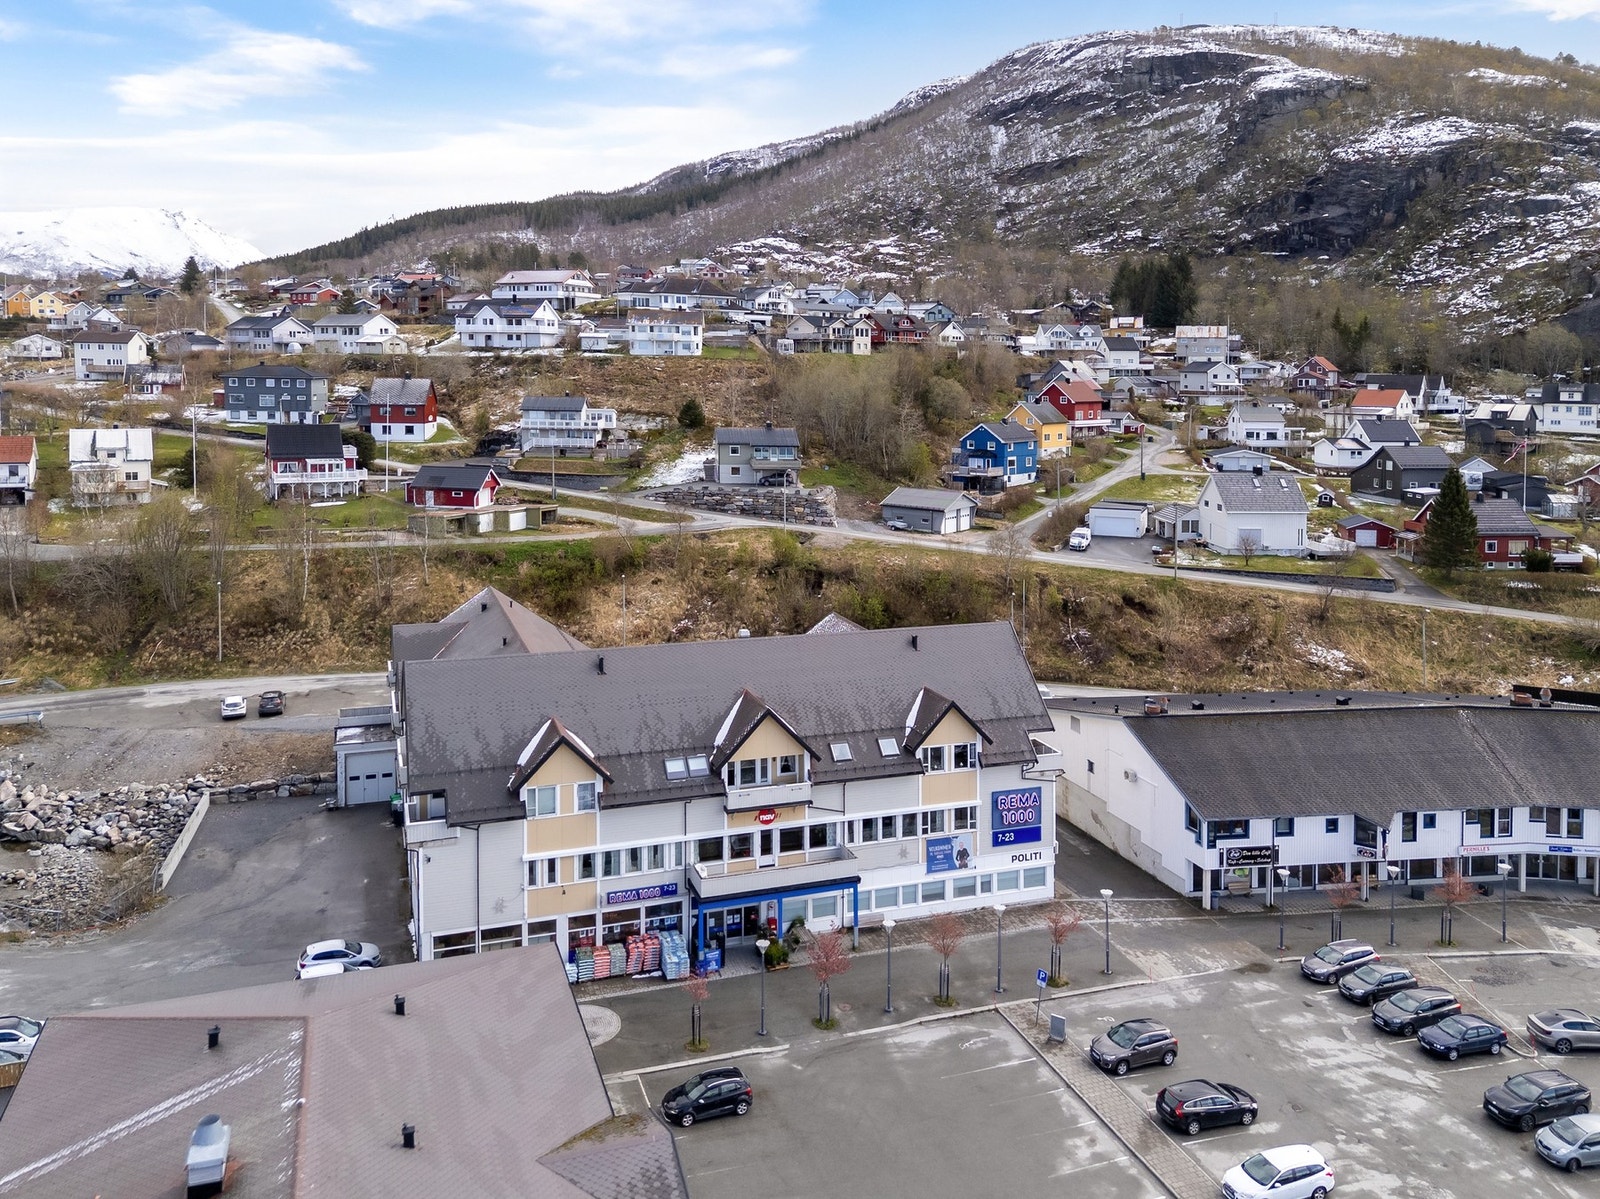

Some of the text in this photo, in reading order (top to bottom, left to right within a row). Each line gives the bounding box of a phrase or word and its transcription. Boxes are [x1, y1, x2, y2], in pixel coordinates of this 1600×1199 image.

[998, 792, 1040, 809] REMA
[1002, 808, 1035, 825] 1000
[997, 832, 1015, 842] 7-23
[1011, 851, 1042, 863] POLITI
[609, 890, 638, 903] REMA
[639, 887, 661, 899] 1000
